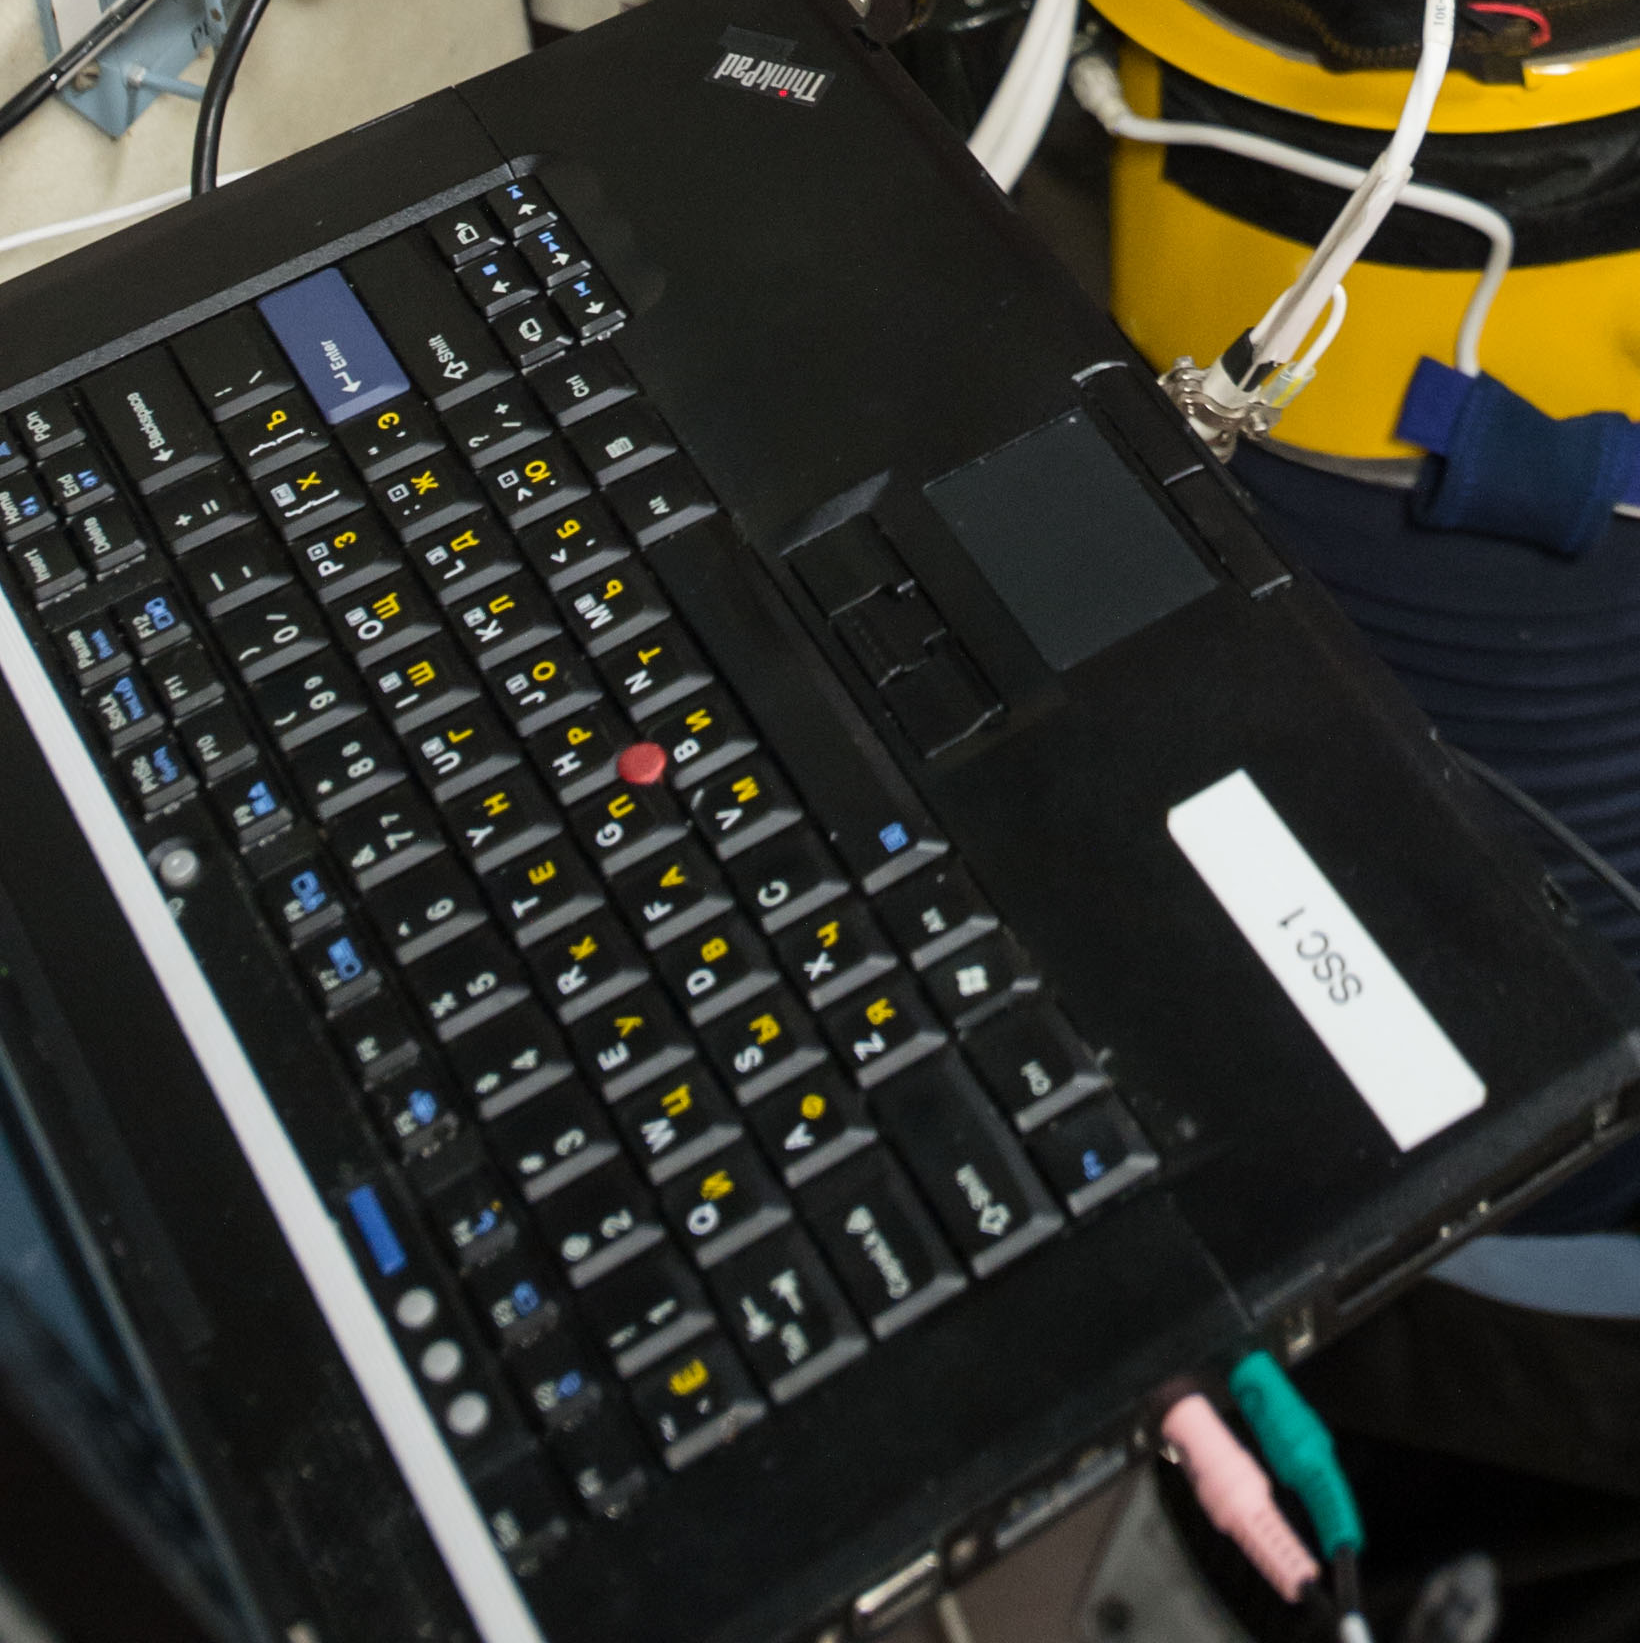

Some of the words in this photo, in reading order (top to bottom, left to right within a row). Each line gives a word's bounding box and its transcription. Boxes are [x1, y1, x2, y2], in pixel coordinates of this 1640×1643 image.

[713, 52, 825, 101] ThinkPad
[320, 339, 347, 370] Enter
[428, 333, 454, 362] Shift
[565, 374, 589, 397] Ctrl
[26, 410, 50, 441] PgDn
[126, 391, 165, 448] Backspace
[266, 409, 287, 430] Ъ
[377, 411, 399, 429] Э
[410, 470, 438, 494] Ж
[524, 459, 550, 482] Ю
[57, 473, 80, 497] End
[0, 490, 22, 525] Home
[649, 495, 670, 514] Alt
[83, 516, 111, 554] Delete
[452, 529, 479, 551] Д
[556, 519, 580, 538] Б
[23, 547, 51, 582] Insert
[318, 559, 344, 576] P
[443, 558, 465, 578] L
[603, 579, 623, 598] Ь
[372, 592, 400, 619] Щ
[488, 594, 514, 613] Л
[584, 603, 613, 628] M
[132, 613, 155, 638] F12
[475, 618, 503, 641] K
[67, 629, 95, 668] Pause
[407, 660, 435, 685] Ш
[624, 669, 652, 693] N
[164, 674, 187, 699] F11
[519, 689, 546, 704] J
[98, 692, 127, 729] ScrLk
[309, 690, 336, 709] 9
[685, 709, 711, 732] И
[196, 734, 221, 761] F10
[447, 728, 472, 742] Г
[432, 750, 461, 773] U
[673, 737, 700, 762] B
[132, 755, 158, 793] PrtSc
[347, 756, 374, 777] 8
[552, 751, 581, 775] H
[608, 794, 634, 818] П
[715, 807, 742, 829] V
[385, 830, 413, 849] 7
[466, 825, 493, 846] Y
[596, 821, 623, 846] G
[757, 880, 789, 906] C
[426, 898, 454, 920] 6
[511, 896, 538, 918] T
[643, 901, 672, 920] F
[1278, 907, 1304, 928] 1
[817, 921, 838, 946] Ч
[804, 951, 833, 980] X
[1295, 930, 1362, 1004] SSC
[466, 971, 496, 996] 5
[557, 964, 586, 994] R
[686, 968, 715, 995] D
[866, 998, 894, 1024] Я
[750, 1014, 779, 1044] Ы
[597, 1042, 628, 1070] E
[853, 1031, 885, 1060] Z
[511, 1048, 537, 1069] 4
[734, 1045, 762, 1072] S
[554, 1128, 584, 1155] 3
[641, 1117, 674, 1152] W
[784, 1122, 813, 1149] A
[601, 1209, 632, 1237] 2
[687, 1201, 718, 1234] Q
